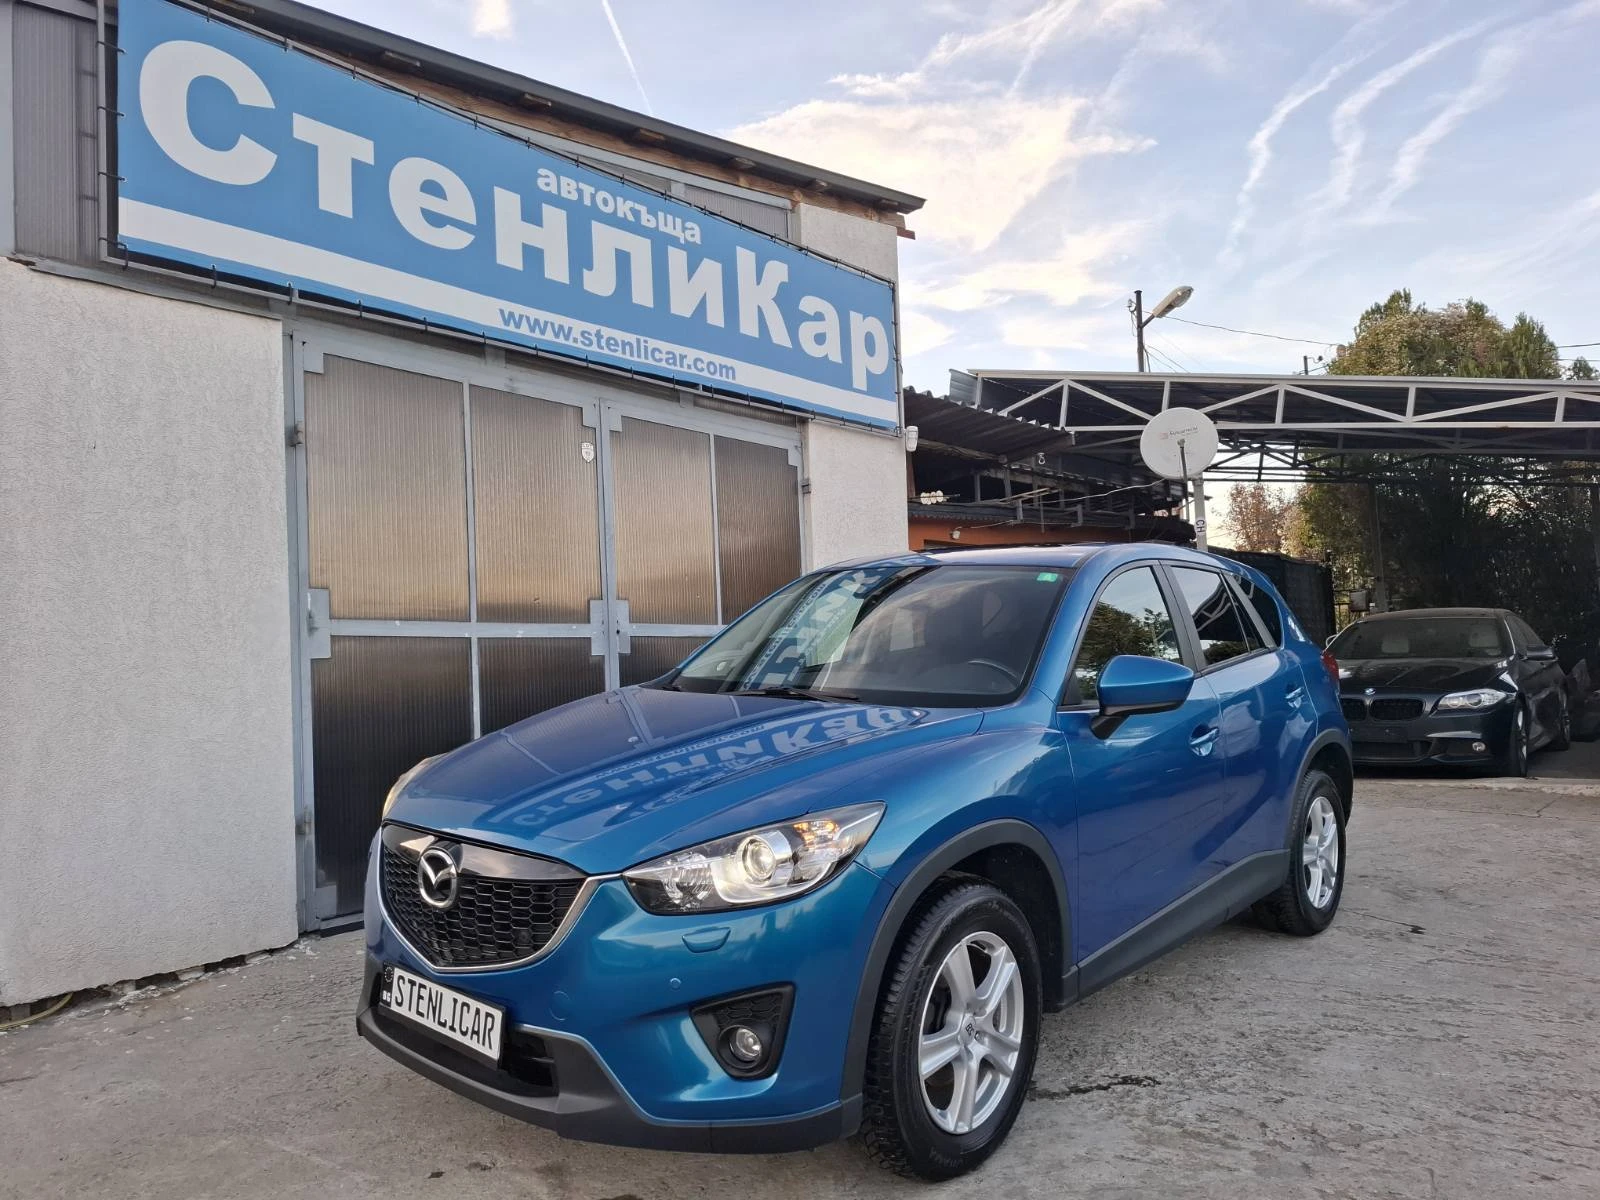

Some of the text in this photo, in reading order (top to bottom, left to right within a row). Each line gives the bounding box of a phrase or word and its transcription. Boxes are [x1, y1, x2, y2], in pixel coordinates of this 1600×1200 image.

[139, 40, 889, 390] СтенлиКар
[537, 168, 701, 245] автокъща
[499, 308, 737, 381] www.stenlicar.com
[394, 975, 496, 1050] STENLICAR
